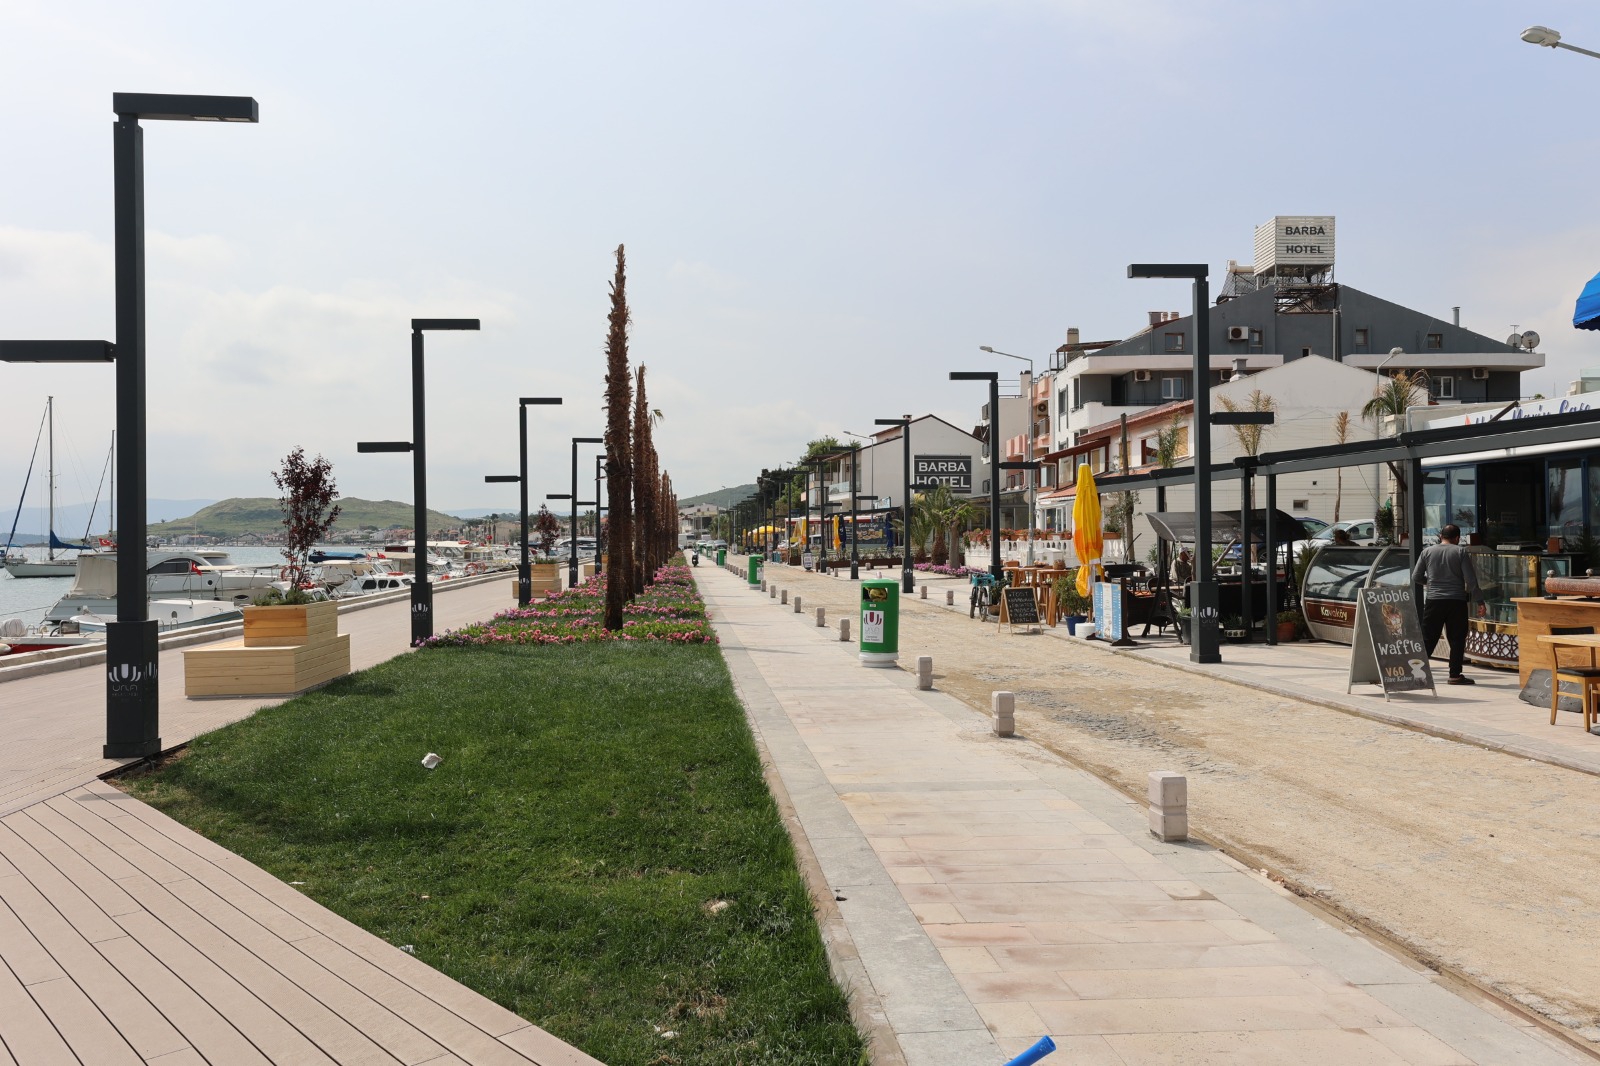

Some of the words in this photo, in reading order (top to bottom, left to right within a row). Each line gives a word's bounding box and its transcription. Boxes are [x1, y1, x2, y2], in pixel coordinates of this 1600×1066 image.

[1285, 226, 1325, 236] BARBA
[1286, 245, 1325, 254] HOTEL
[918, 462, 967, 472] BARBA
[916, 476, 970, 488] HOTEL
[1367, 590, 1410, 604] Bubble
[1385, 666, 1405, 677] V60
